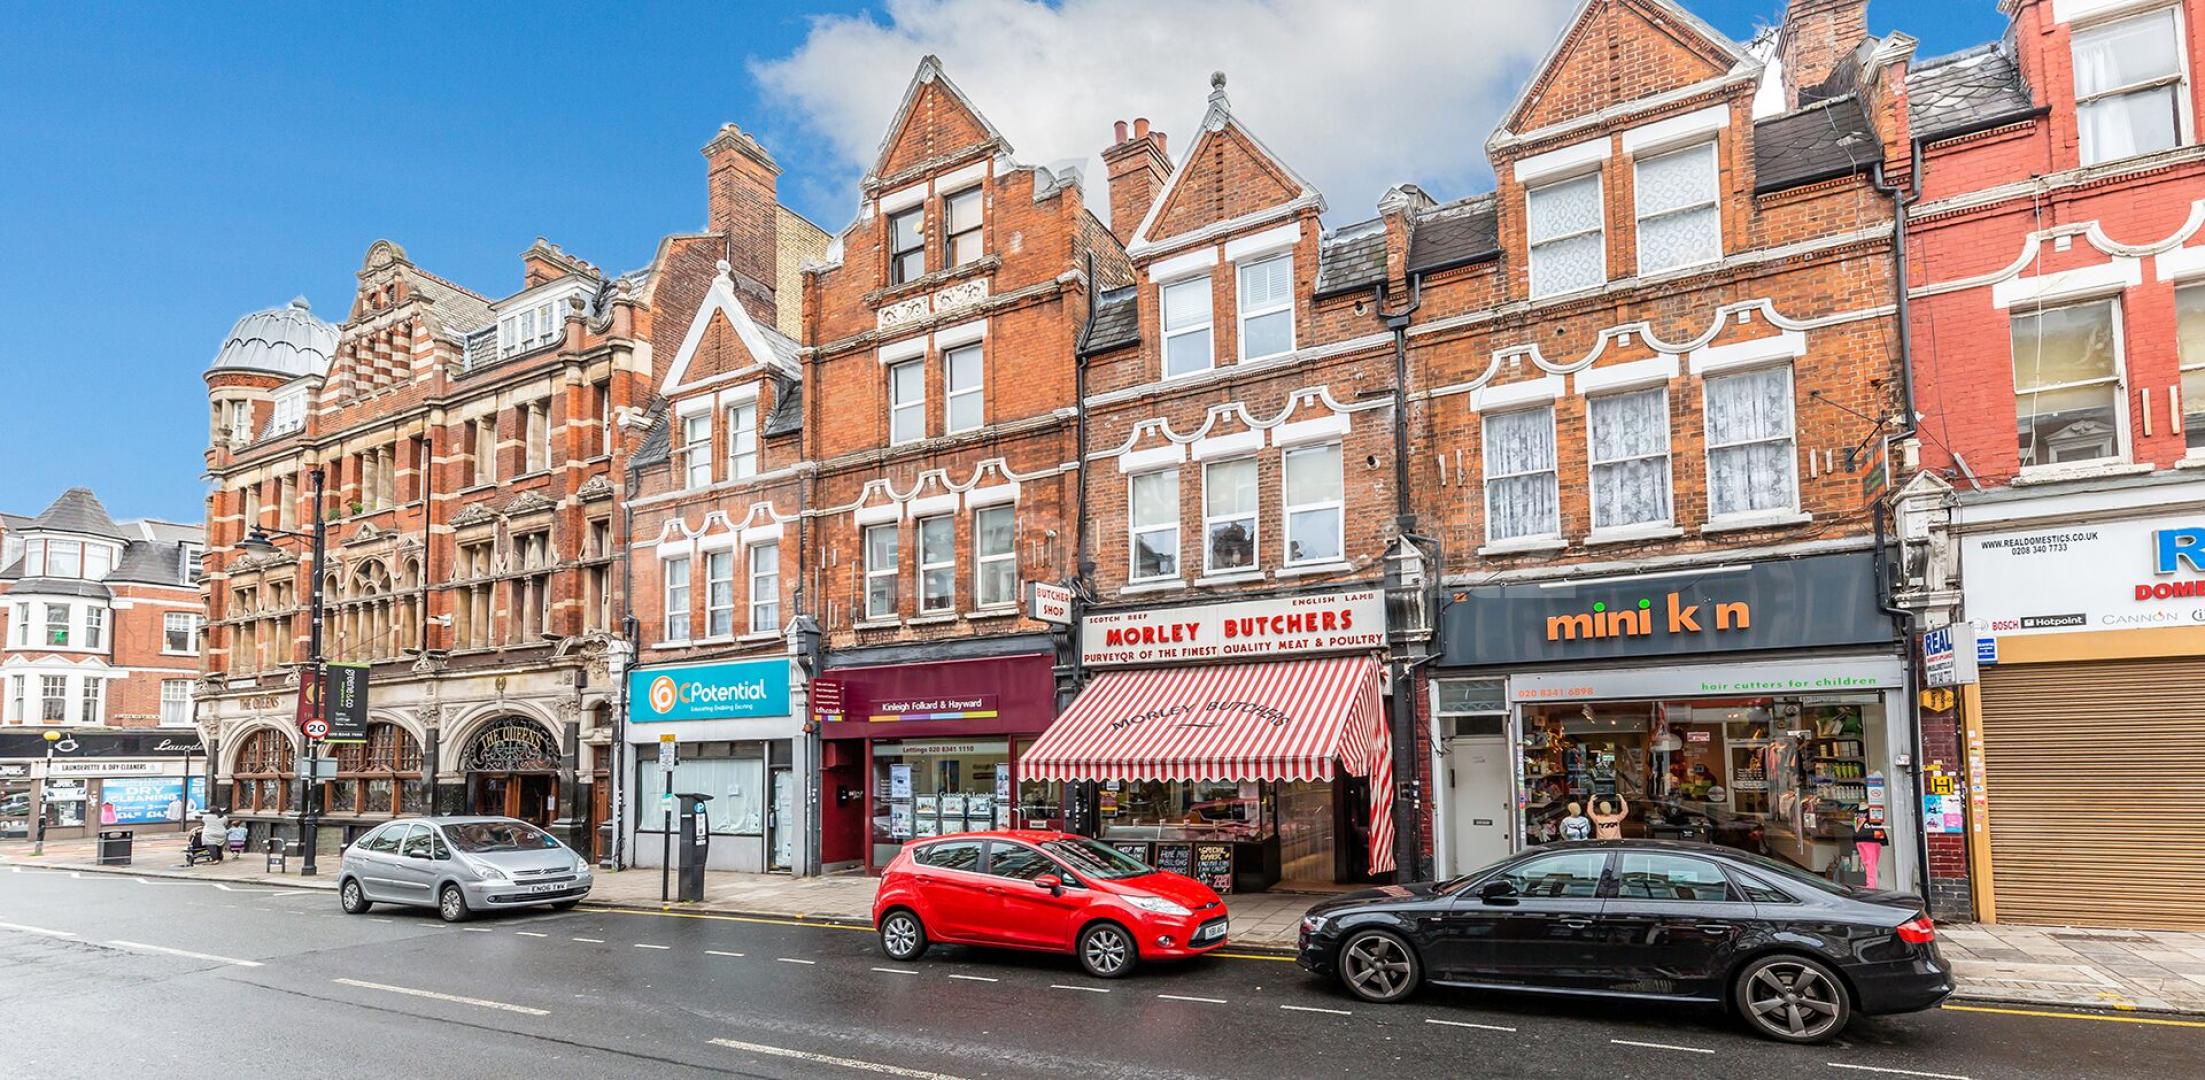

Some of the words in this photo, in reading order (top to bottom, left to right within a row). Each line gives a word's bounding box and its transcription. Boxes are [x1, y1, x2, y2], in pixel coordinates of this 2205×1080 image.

[1981, 532, 2098, 549] WWW.REALDOMESTICS.CO.UK
[2011, 546, 2031, 556] 0208
[2032, 545, 2047, 554] 340
[2048, 543, 2068, 552] 7733
[1036, 587, 1070, 602] BUTCHER
[1292, 596, 1335, 606] ENGLISH
[1345, 593, 1374, 601] LAMB
[1043, 604, 1065, 617] SHOP
[1089, 615, 1120, 624] SCOTCH
[1992, 620, 2019, 631] BOSCH
[2035, 614, 2083, 626] Hotpoint
[1106, 622, 1200, 647] MORLEY
[1224, 609, 1352, 639] BUTCHERS
[1139, 650, 1153, 659] OF
[1158, 648, 1177, 658] THE
[1182, 646, 1217, 656] FINEST
[1223, 642, 1272, 654] QUALITY
[1278, 639, 1309, 650] MEAT
[1315, 638, 1323, 647] &
[1329, 633, 1383, 646] POULTRY
[1925, 628, 1953, 656] REAL
[1702, 682, 1728, 690] hair
[1734, 681, 1783, 689] cutters
[1788, 680, 1808, 688] for
[1815, 677, 1877, 687] children
[1518, 689, 1536, 697] 020
[1540, 688, 1564, 697] 8341
[1567, 687, 1593, 696] 6898
[882, 703, 910, 712] Kinleigh
[912, 700, 938, 710] Folkard
[940, 701, 946, 709] &
[948, 698, 982, 710] Hayward
[1112, 703, 1195, 730] MORLEY
[1206, 701, 1290, 727] BUTCHERS
[308, 724, 326, 733] 20
[482, 729, 498, 749] THE
[503, 727, 541, 749] QUEENS
[61, 763, 100, 771] LAUNDERETTE
